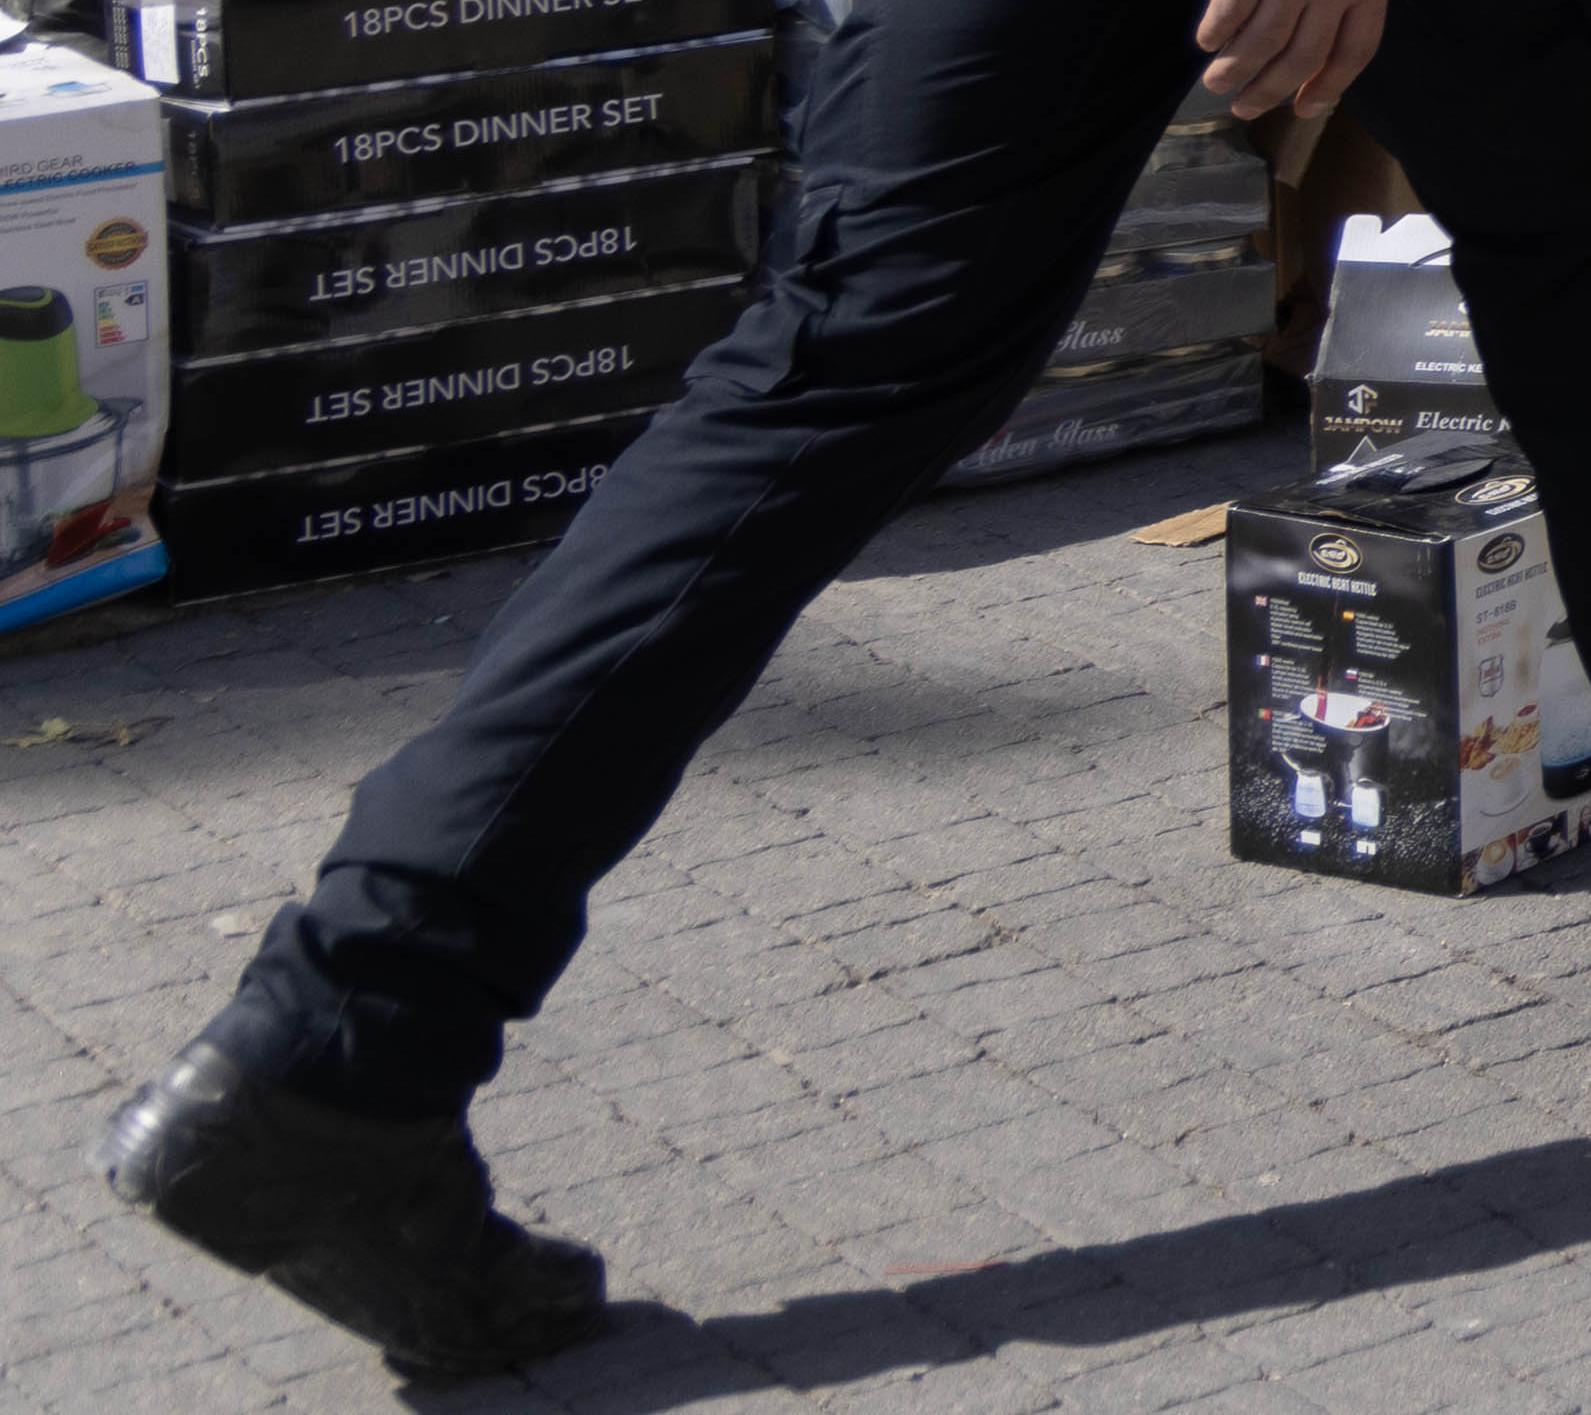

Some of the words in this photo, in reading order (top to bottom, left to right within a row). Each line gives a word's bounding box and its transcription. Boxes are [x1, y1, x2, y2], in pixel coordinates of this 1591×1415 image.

[195, 6, 209, 78] 18PCS
[333, 122, 443, 165] 18PCS
[452, 102, 594, 148] DINNER
[601, 92, 664, 126] SET
[37, 153, 84, 173] GEAR
[532, 224, 639, 267] 18PCS
[308, 265, 376, 303] SET
[384, 241, 525, 290] DINNER
[529, 343, 635, 386] 18PCS
[1413, 360, 1467, 373] ELECTRIC
[381, 361, 522, 411] DINNER
[304, 387, 373, 425] SET
[1415, 410, 1494, 432] Electric
[1047, 418, 1121, 452] Glass
[1321, 416, 1405, 435] JAMPOW
[521, 463, 609, 503] 8PCS
[372, 479, 513, 529] DINNER
[296, 510, 362, 544] SET
[1298, 571, 1331, 589] ELECTRIC
[1331, 576, 1351, 592] HEAT
[1351, 579, 1378, 597] KETTLE
[1475, 579, 1507, 600] ELECTRIC
[1506, 571, 1525, 587] HEAT
[1524, 561, 1549, 581] KETTLE
